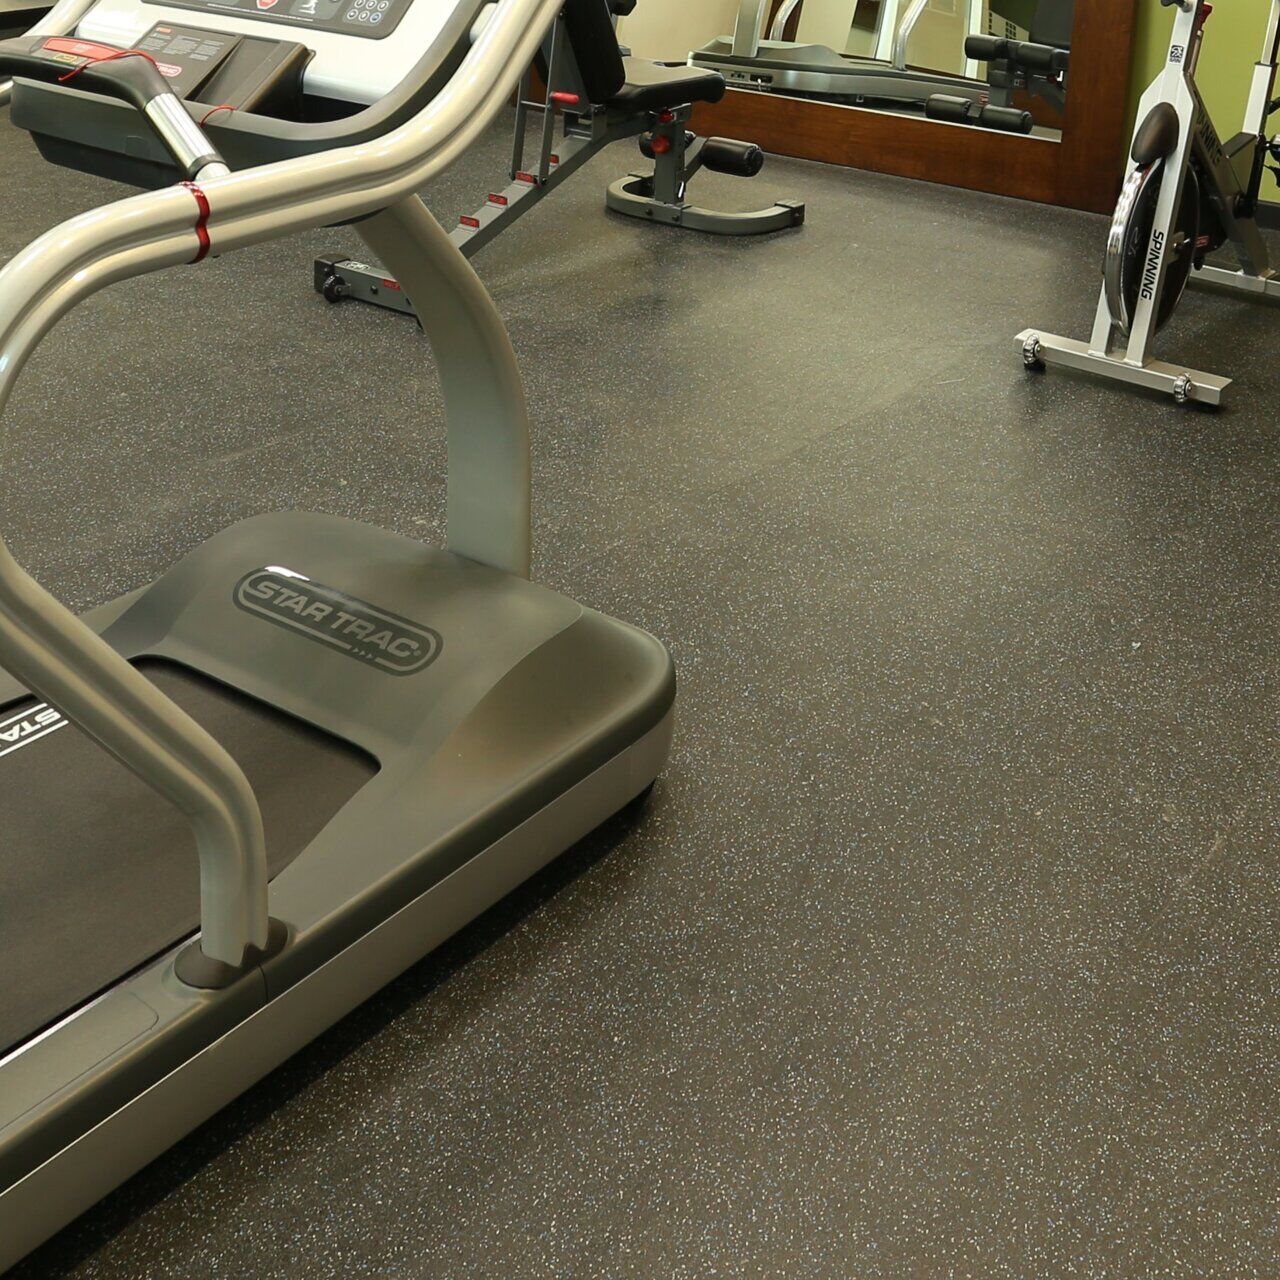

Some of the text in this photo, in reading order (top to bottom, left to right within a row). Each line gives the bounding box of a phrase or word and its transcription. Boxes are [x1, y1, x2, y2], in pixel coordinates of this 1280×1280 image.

[1141, 229, 1164, 301] SPINNING
[252, 580, 420, 658] STAR TRAC
